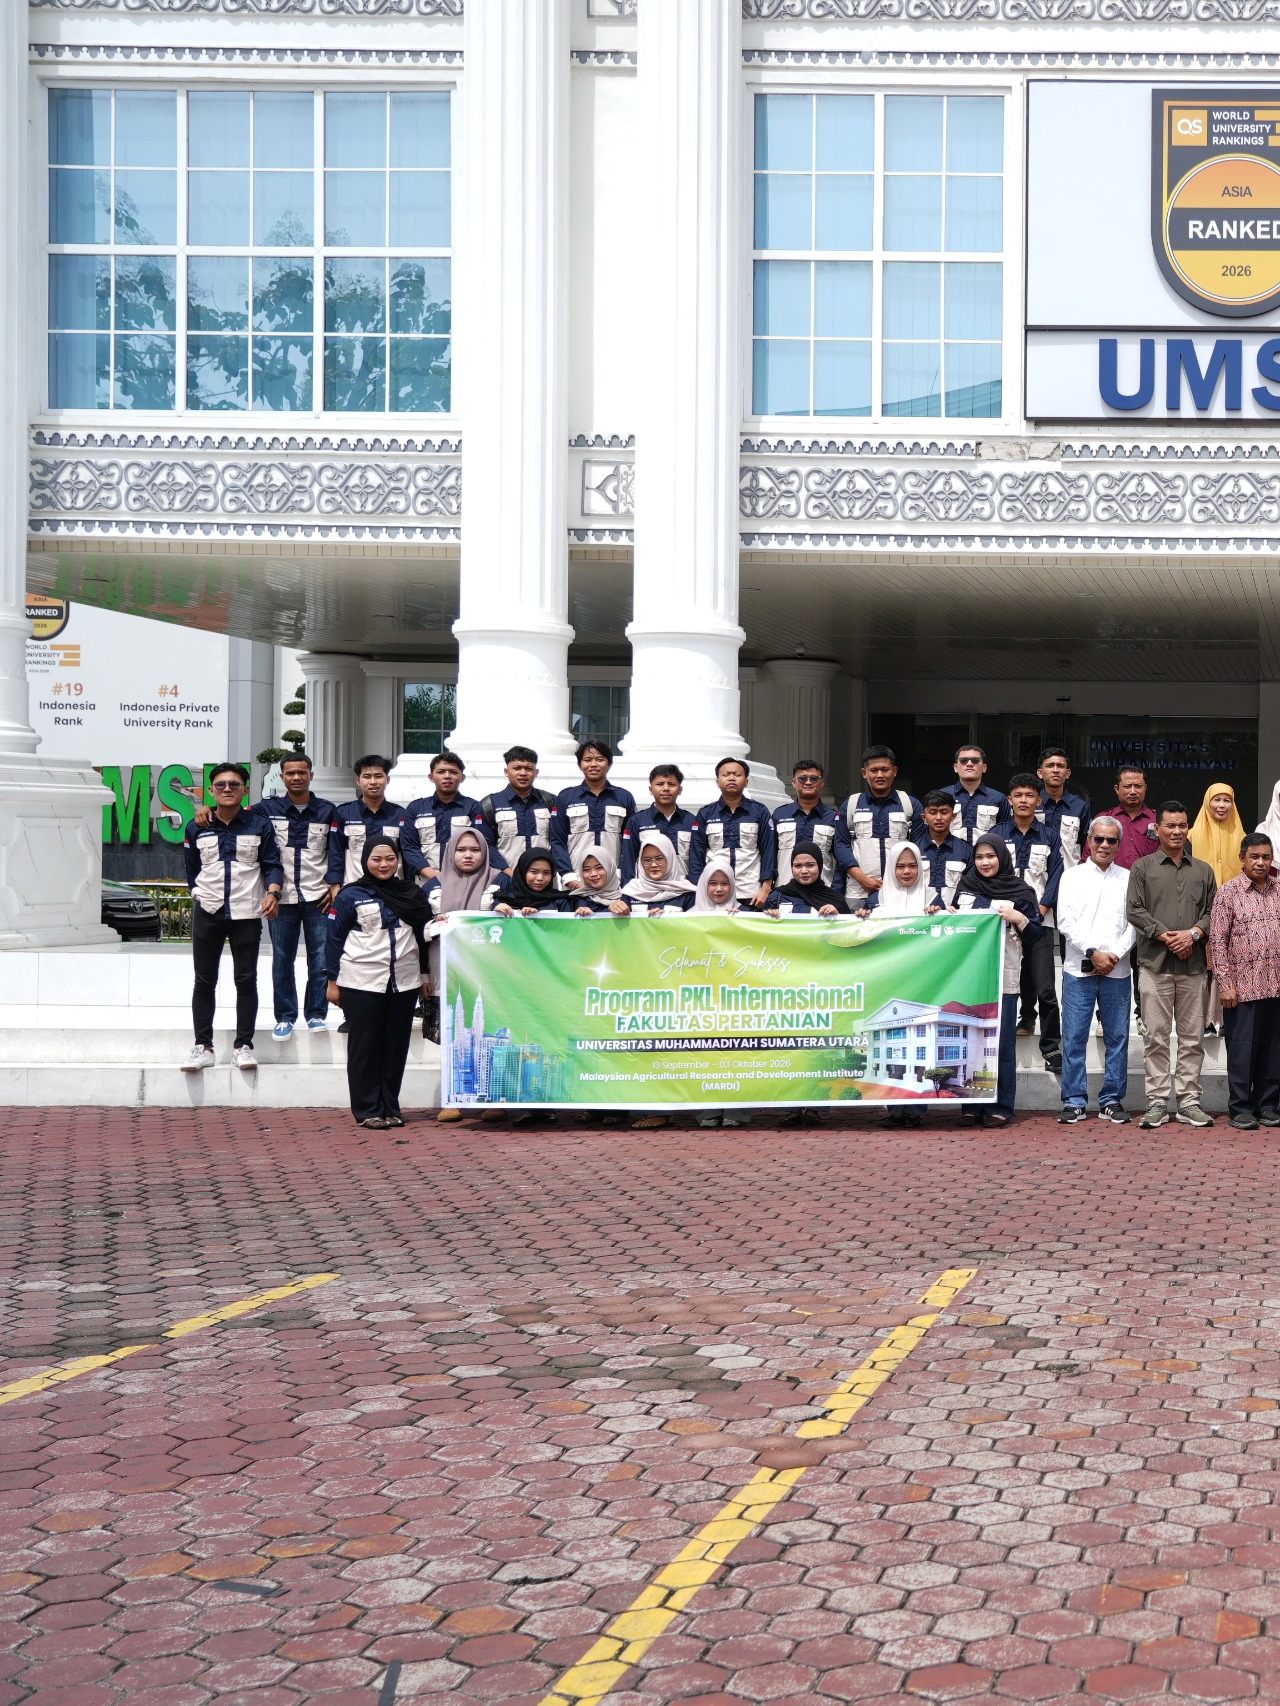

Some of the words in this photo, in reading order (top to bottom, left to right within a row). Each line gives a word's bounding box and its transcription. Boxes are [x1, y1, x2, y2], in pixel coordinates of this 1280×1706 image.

[1212, 111, 1250, 121] WORLD
[1177, 118, 1203, 137] QS
[1212, 124, 1271, 133] UNIVERSITY
[1212, 136, 1264, 146] RANKINGS
[1221, 186, 1252, 198] ASIA
[1221, 265, 1252, 277] 2026
[52, 683, 84, 696] #19
[158, 684, 179, 698] #4
[39, 701, 96, 711] Indonesia
[119, 702, 176, 712] Indonesia
[179, 703, 220, 713] Private
[54, 716, 83, 726] Rank
[123, 718, 182, 730] University
[184, 719, 213, 728] Rank
[1089, 740, 1211, 753] UNIVERSITAS
[658, 946, 722, 978] Selamat
[717, 954, 727, 968] &
[733, 945, 791, 978] Sukses
[586, 988, 675, 1016] Program
[680, 986, 716, 1012] PKL
[720, 984, 863, 1011] Internasional
[617, 1014, 714, 1030] FAKULTAS
[718, 1012, 830, 1029] PERTANIAN
[576, 1039, 653, 1050] UNIVERSITAS
[655, 1037, 758, 1049] MUHAMMADIYAH
[760, 1037, 826, 1048] SUMATERA
[828, 1036, 869, 1047] UTARA
[652, 1061, 661, 1069] 13
[662, 1060, 710, 1071] September
[719, 1060, 730, 1069] 03
[731, 1059, 768, 1068] Oktober
[769, 1059, 792, 1068] 2026
[579, 1072, 631, 1082] Malaysian
[633, 1071, 688, 1083] Agricultural
[689, 1071, 735, 1080] Research
[736, 1070, 755, 1079] and
[756, 1070, 821, 1080] Development
[823, 1068, 864, 1078] Institute
[701, 1082, 740, 1093] (MARDI)
